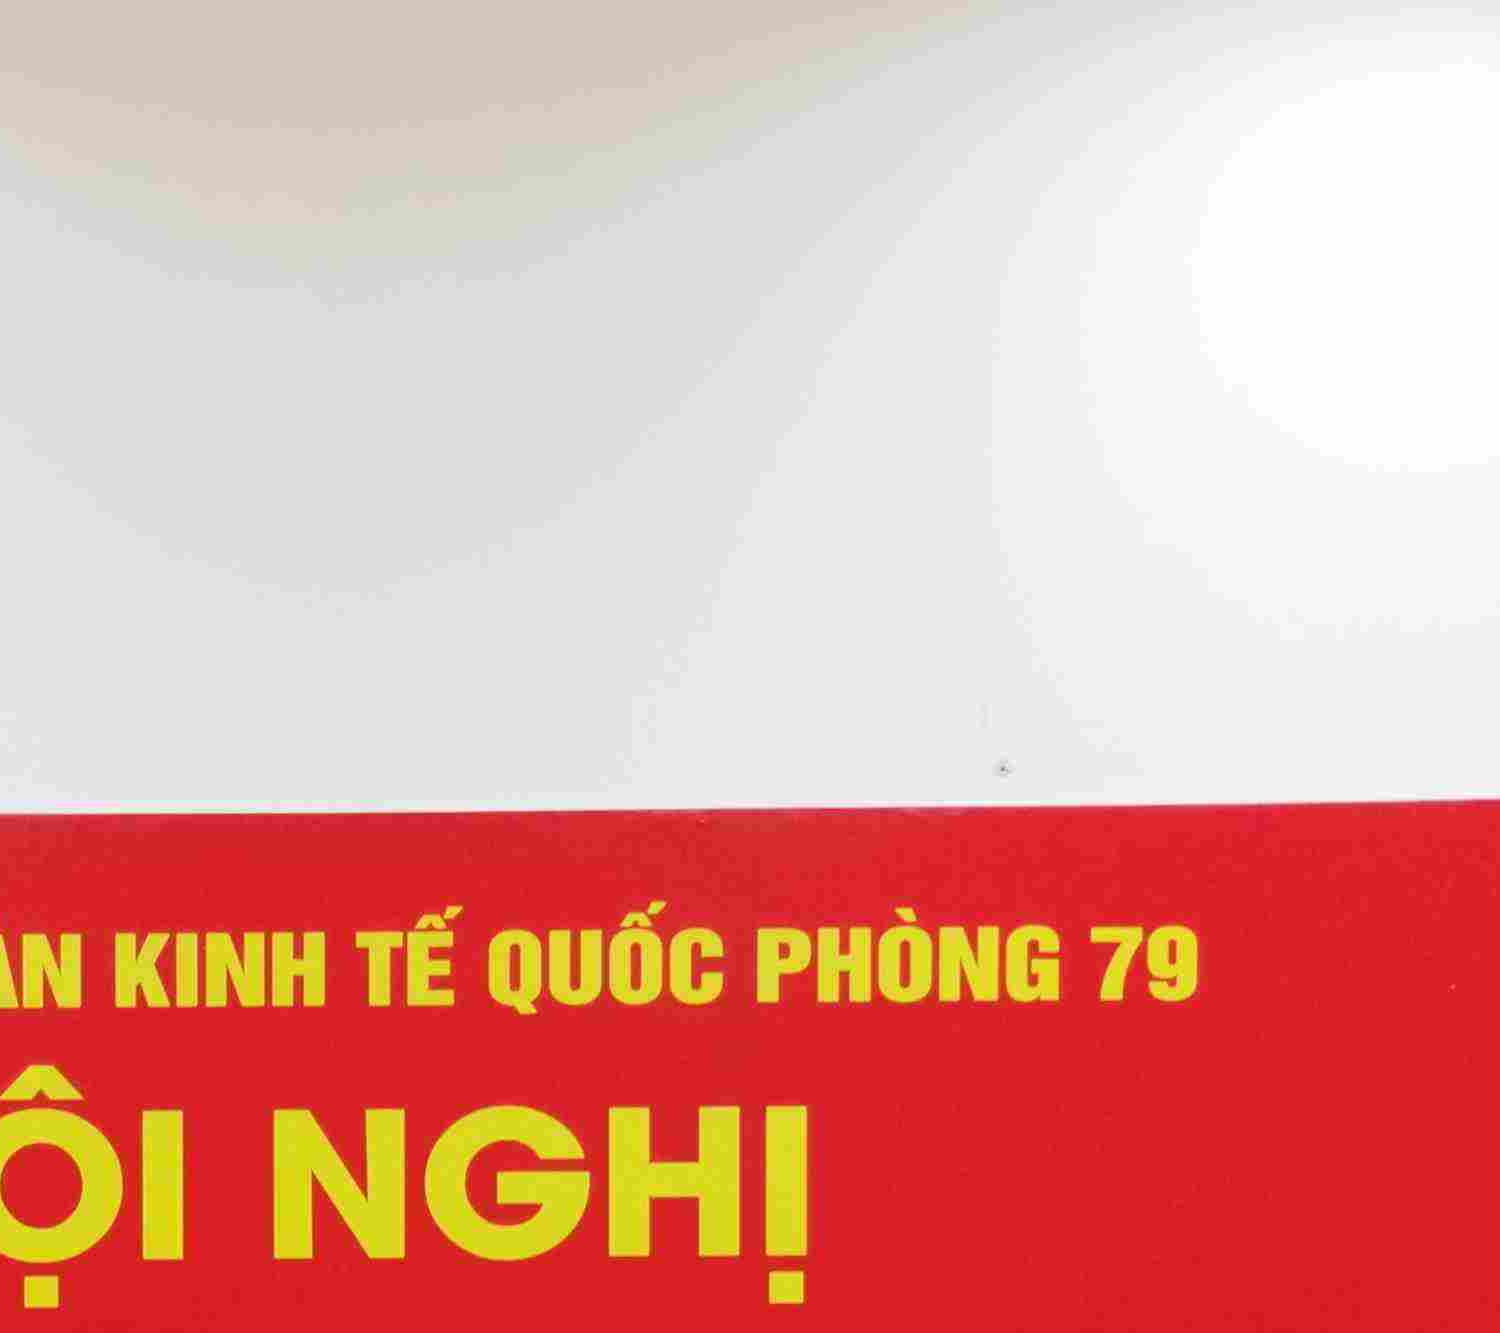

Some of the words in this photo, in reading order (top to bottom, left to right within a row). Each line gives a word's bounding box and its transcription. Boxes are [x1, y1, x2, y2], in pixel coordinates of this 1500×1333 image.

[114, 930, 326, 1010] KINH
[355, 905, 463, 1008] TẾ
[487, 900, 725, 1016] QUỐC
[756, 906, 1061, 1005] PHÒNG
[1089, 924, 1199, 1003] 79
[272, 1103, 808, 1306] NGHỊ
